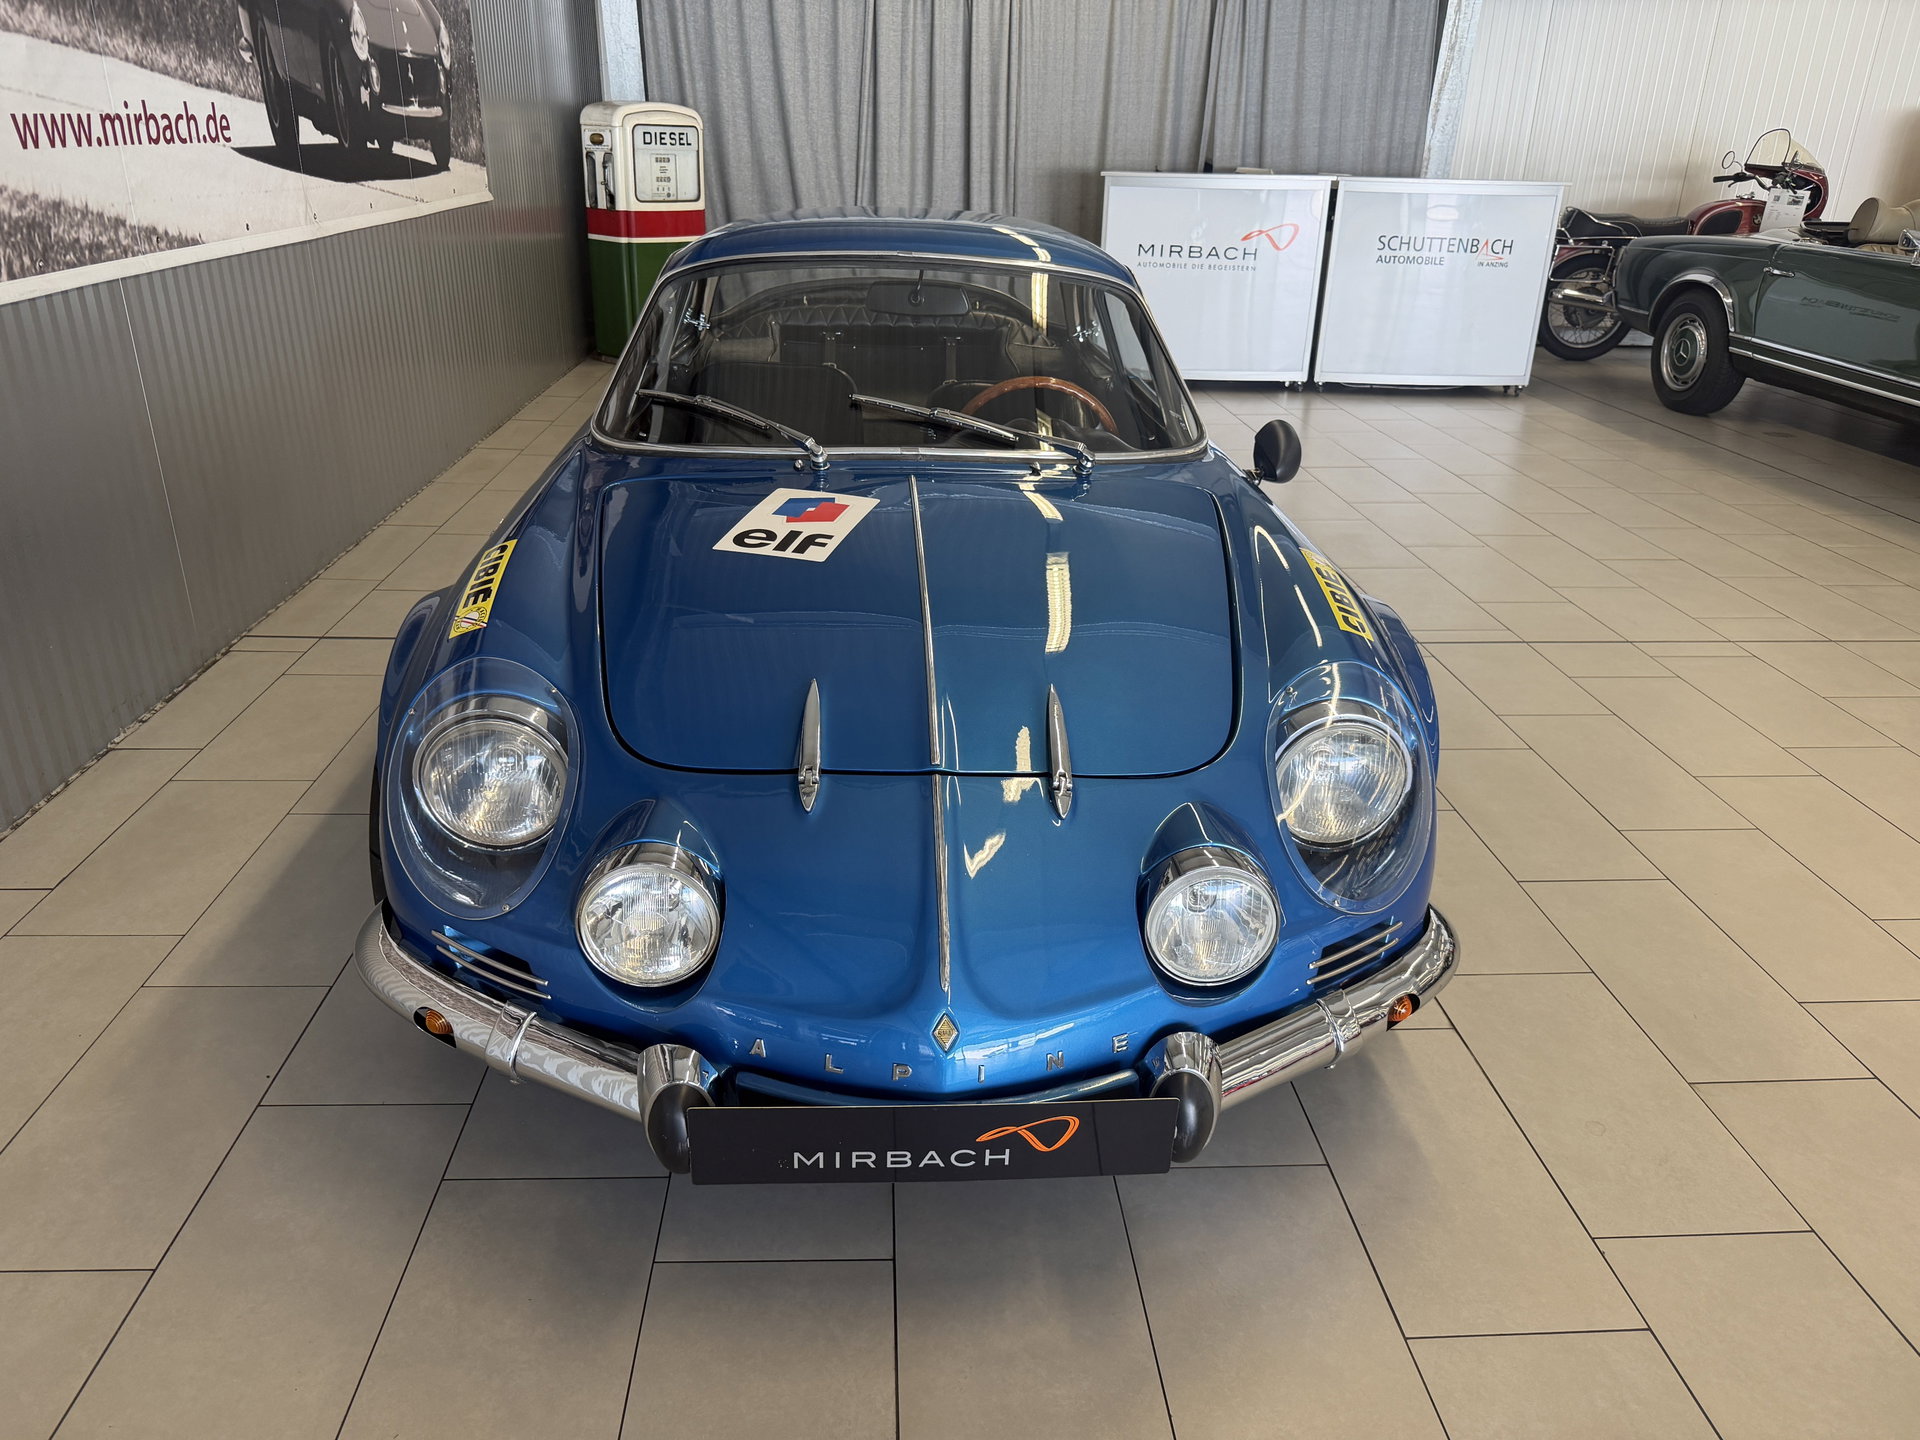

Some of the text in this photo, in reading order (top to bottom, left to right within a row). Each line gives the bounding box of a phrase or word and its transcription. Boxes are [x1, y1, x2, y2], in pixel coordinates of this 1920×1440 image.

[10, 99, 232, 150] www.mirbach.de
[642, 131, 692, 146] DIESEL
[1137, 243, 1258, 261] MIRBACH
[1377, 234, 1514, 256] SCHUTTENBACH
[1136, 261, 1188, 270] AUTOMOBILE
[1208, 264, 1257, 272] BEGEISTERN
[1376, 254, 1445, 266] AUTOMOBILE
[732, 528, 835, 555] elf
[749, 1032, 1130, 1083] ALPINE
[792, 1147, 1011, 1170] MIRBACH
